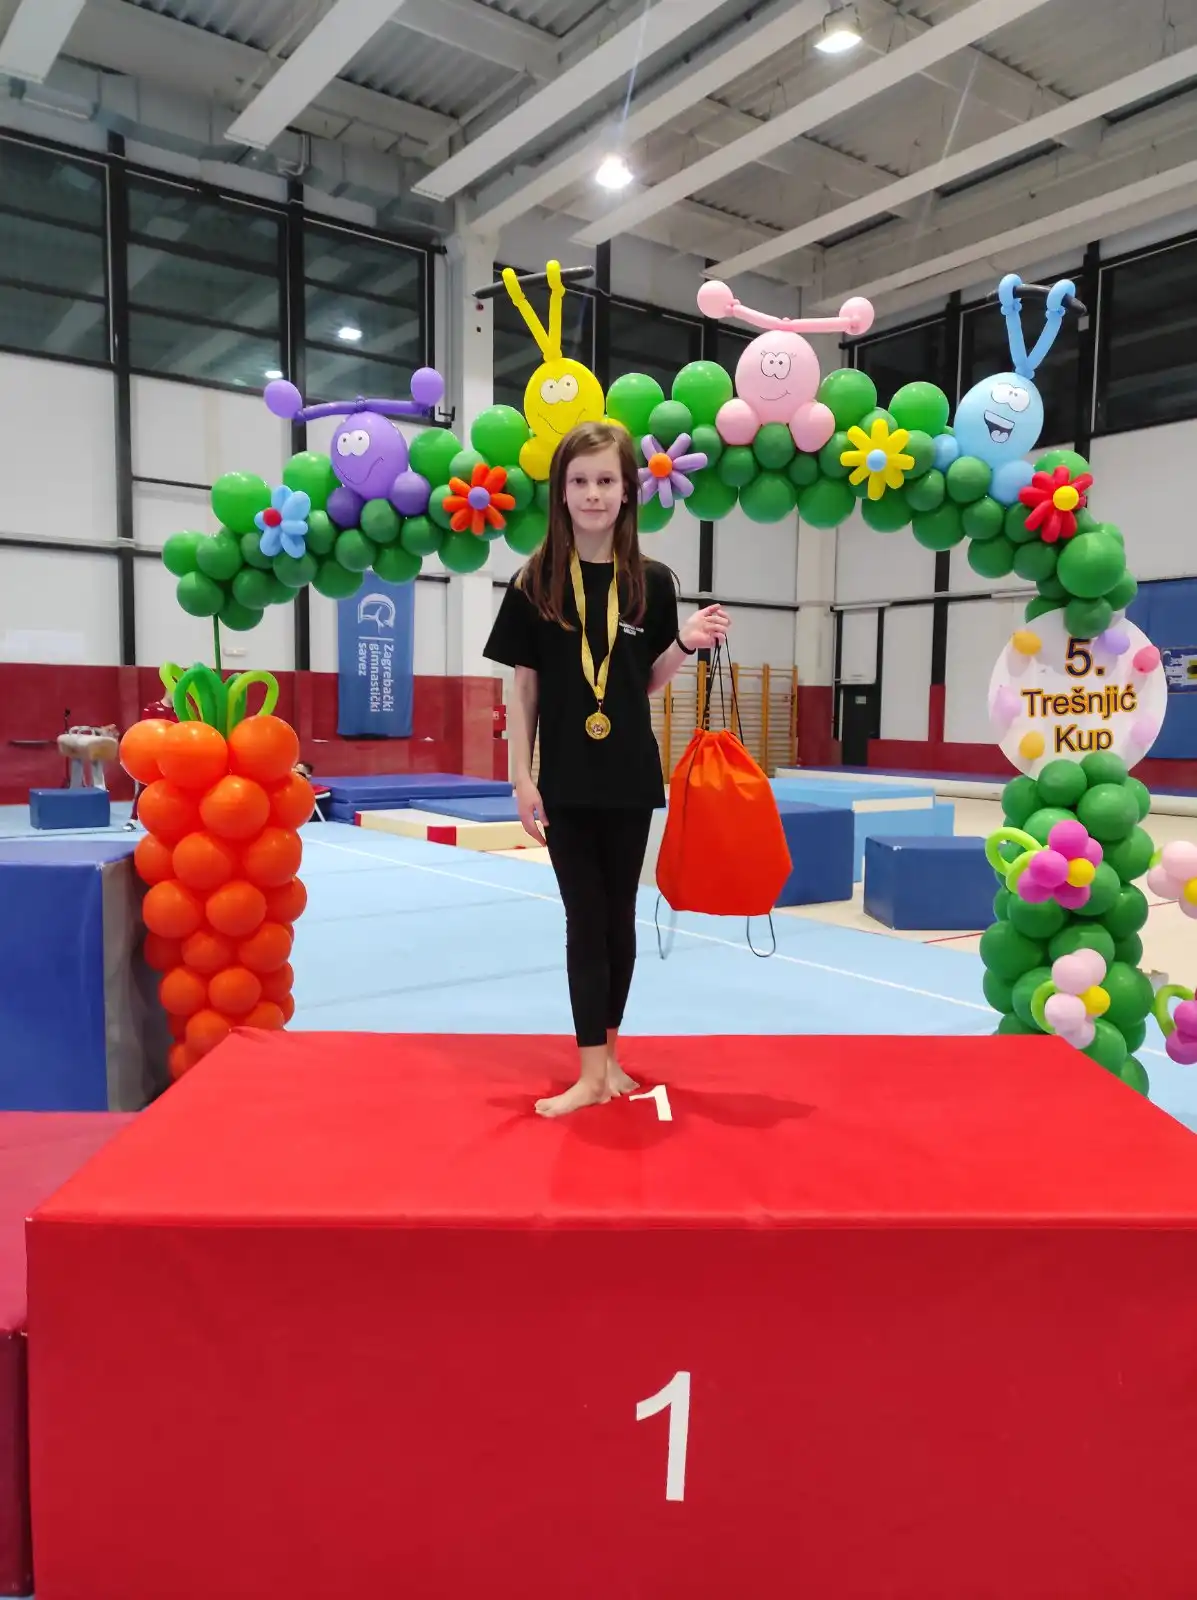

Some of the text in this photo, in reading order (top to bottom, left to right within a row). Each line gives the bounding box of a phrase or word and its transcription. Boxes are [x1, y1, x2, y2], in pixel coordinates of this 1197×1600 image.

[358, 642, 368, 676] savez
[1065, 636, 1106, 678] 5.
[369, 643, 381, 712] gimnastički
[381, 643, 395, 712] Zagrebački
[1021, 683, 1138, 720] Trešnjić
[1054, 723, 1114, 754] Kup
[628, 1084, 673, 1121] 1
[636, 1370, 691, 1501] 1
